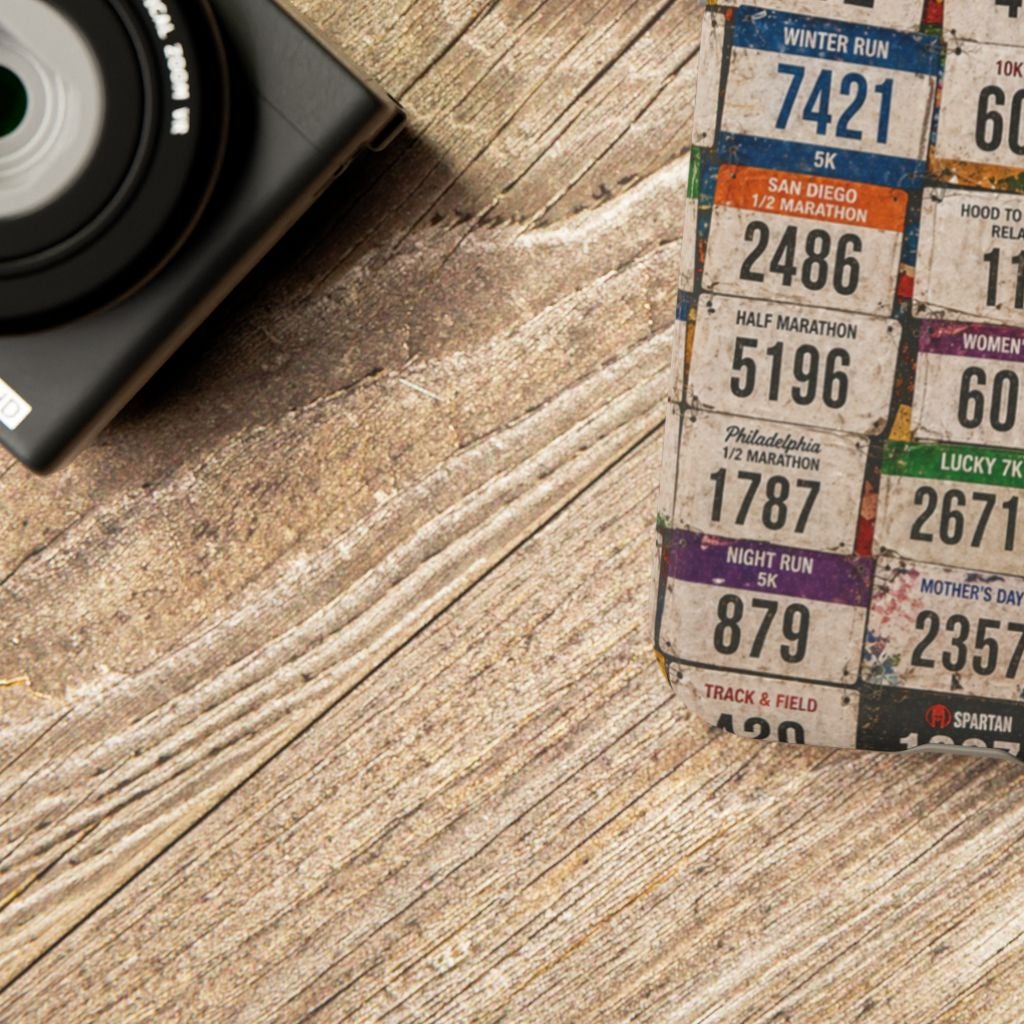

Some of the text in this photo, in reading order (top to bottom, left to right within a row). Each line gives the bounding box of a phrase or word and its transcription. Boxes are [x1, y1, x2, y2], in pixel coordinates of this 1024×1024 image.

[784, 27, 889, 60] WINTER RUN
[996, 60, 1024, 78] 10K
[775, 63, 893, 144] 7421
[813, 151, 837, 170] 5K
[768, 177, 857, 205] SAN DIEGO
[751, 193, 868, 223] 1/2 MARATHON
[961, 204, 1000, 220] HOOD
[1005, 208, 1024, 223] TO
[739, 220, 862, 296] 2486
[736, 310, 857, 340] HALF MARATHON
[730, 336, 851, 409] 5196
[723, 425, 822, 454] Philadelphia
[722, 446, 820, 471] 1/2 MARATHON
[940, 452, 1024, 478] LUCKY 7K
[710, 467, 821, 534] 1787
[910, 485, 1019, 551] 2671
[726, 546, 814, 574] NIGHT RUN
[757, 572, 778, 588] 5K
[920, 578, 992, 602] MOTHER'S
[996, 588, 1024, 607] DAY
[713, 593, 810, 664] 879
[704, 683, 818, 713] TRACK & FIELD
[953, 711, 1013, 733] SPARTAN
